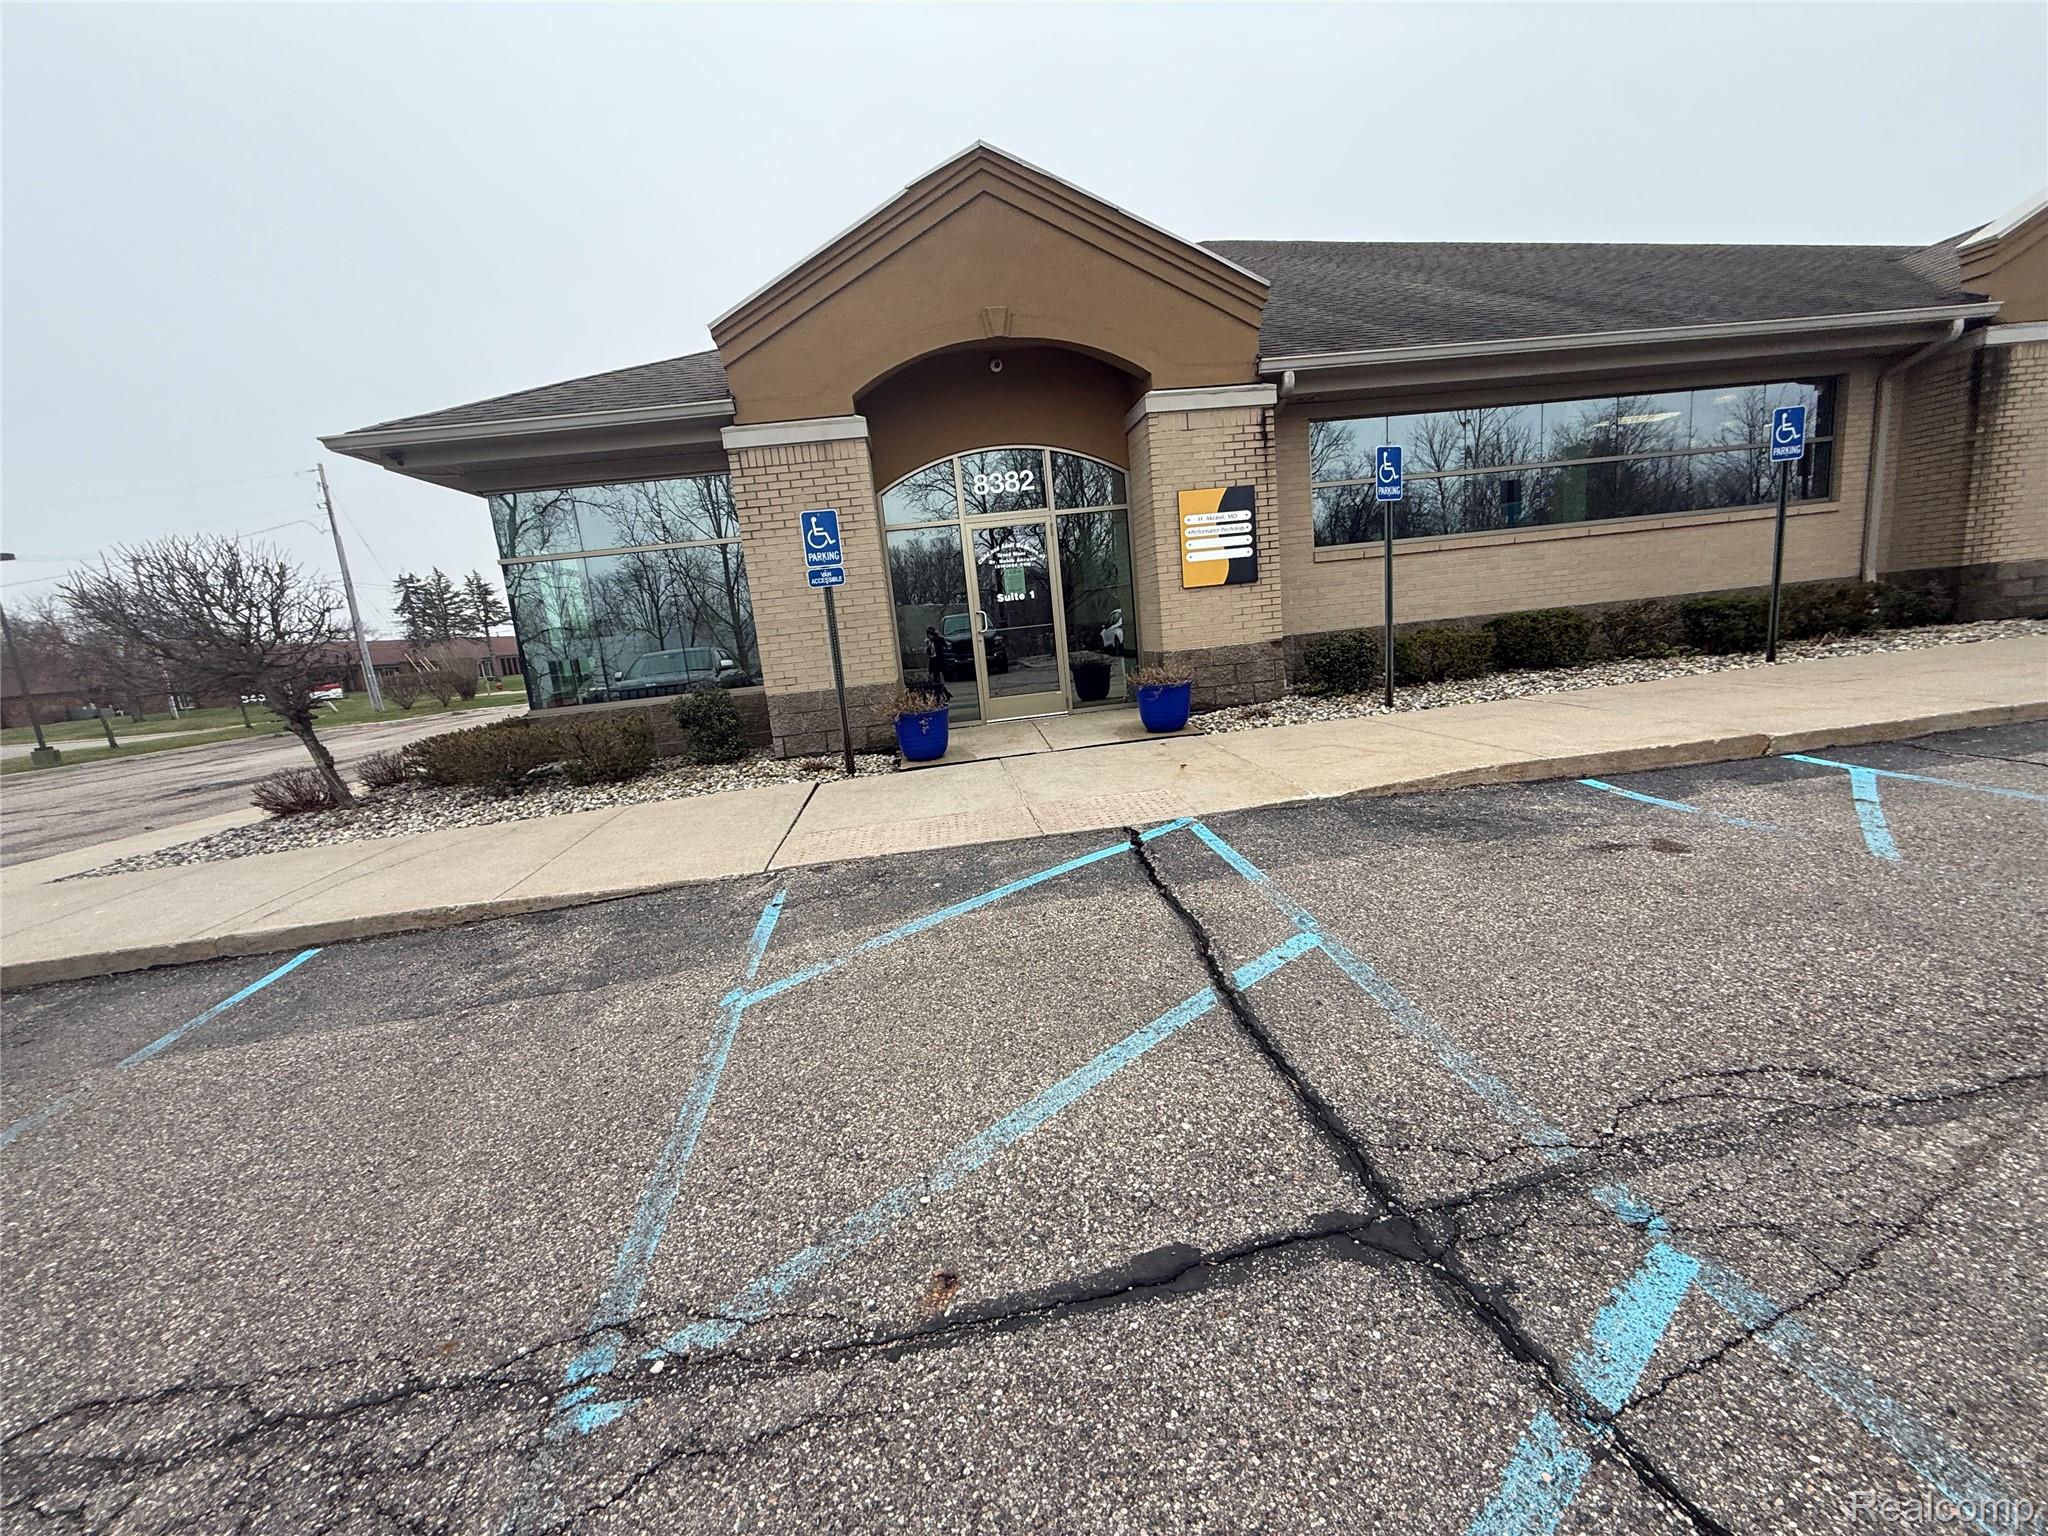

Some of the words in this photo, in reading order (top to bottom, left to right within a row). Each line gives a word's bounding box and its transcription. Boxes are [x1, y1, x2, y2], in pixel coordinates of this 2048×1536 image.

[1773, 445, 1801, 456] PARKING
[974, 470, 1034, 494] 8382
[1378, 486, 1401, 496] PARKING
[808, 551, 840, 563] PARKING
[811, 576, 842, 584] ACCESSIBLE
[997, 592, 1025, 602] Suite
[1030, 590, 1035, 598] 1
